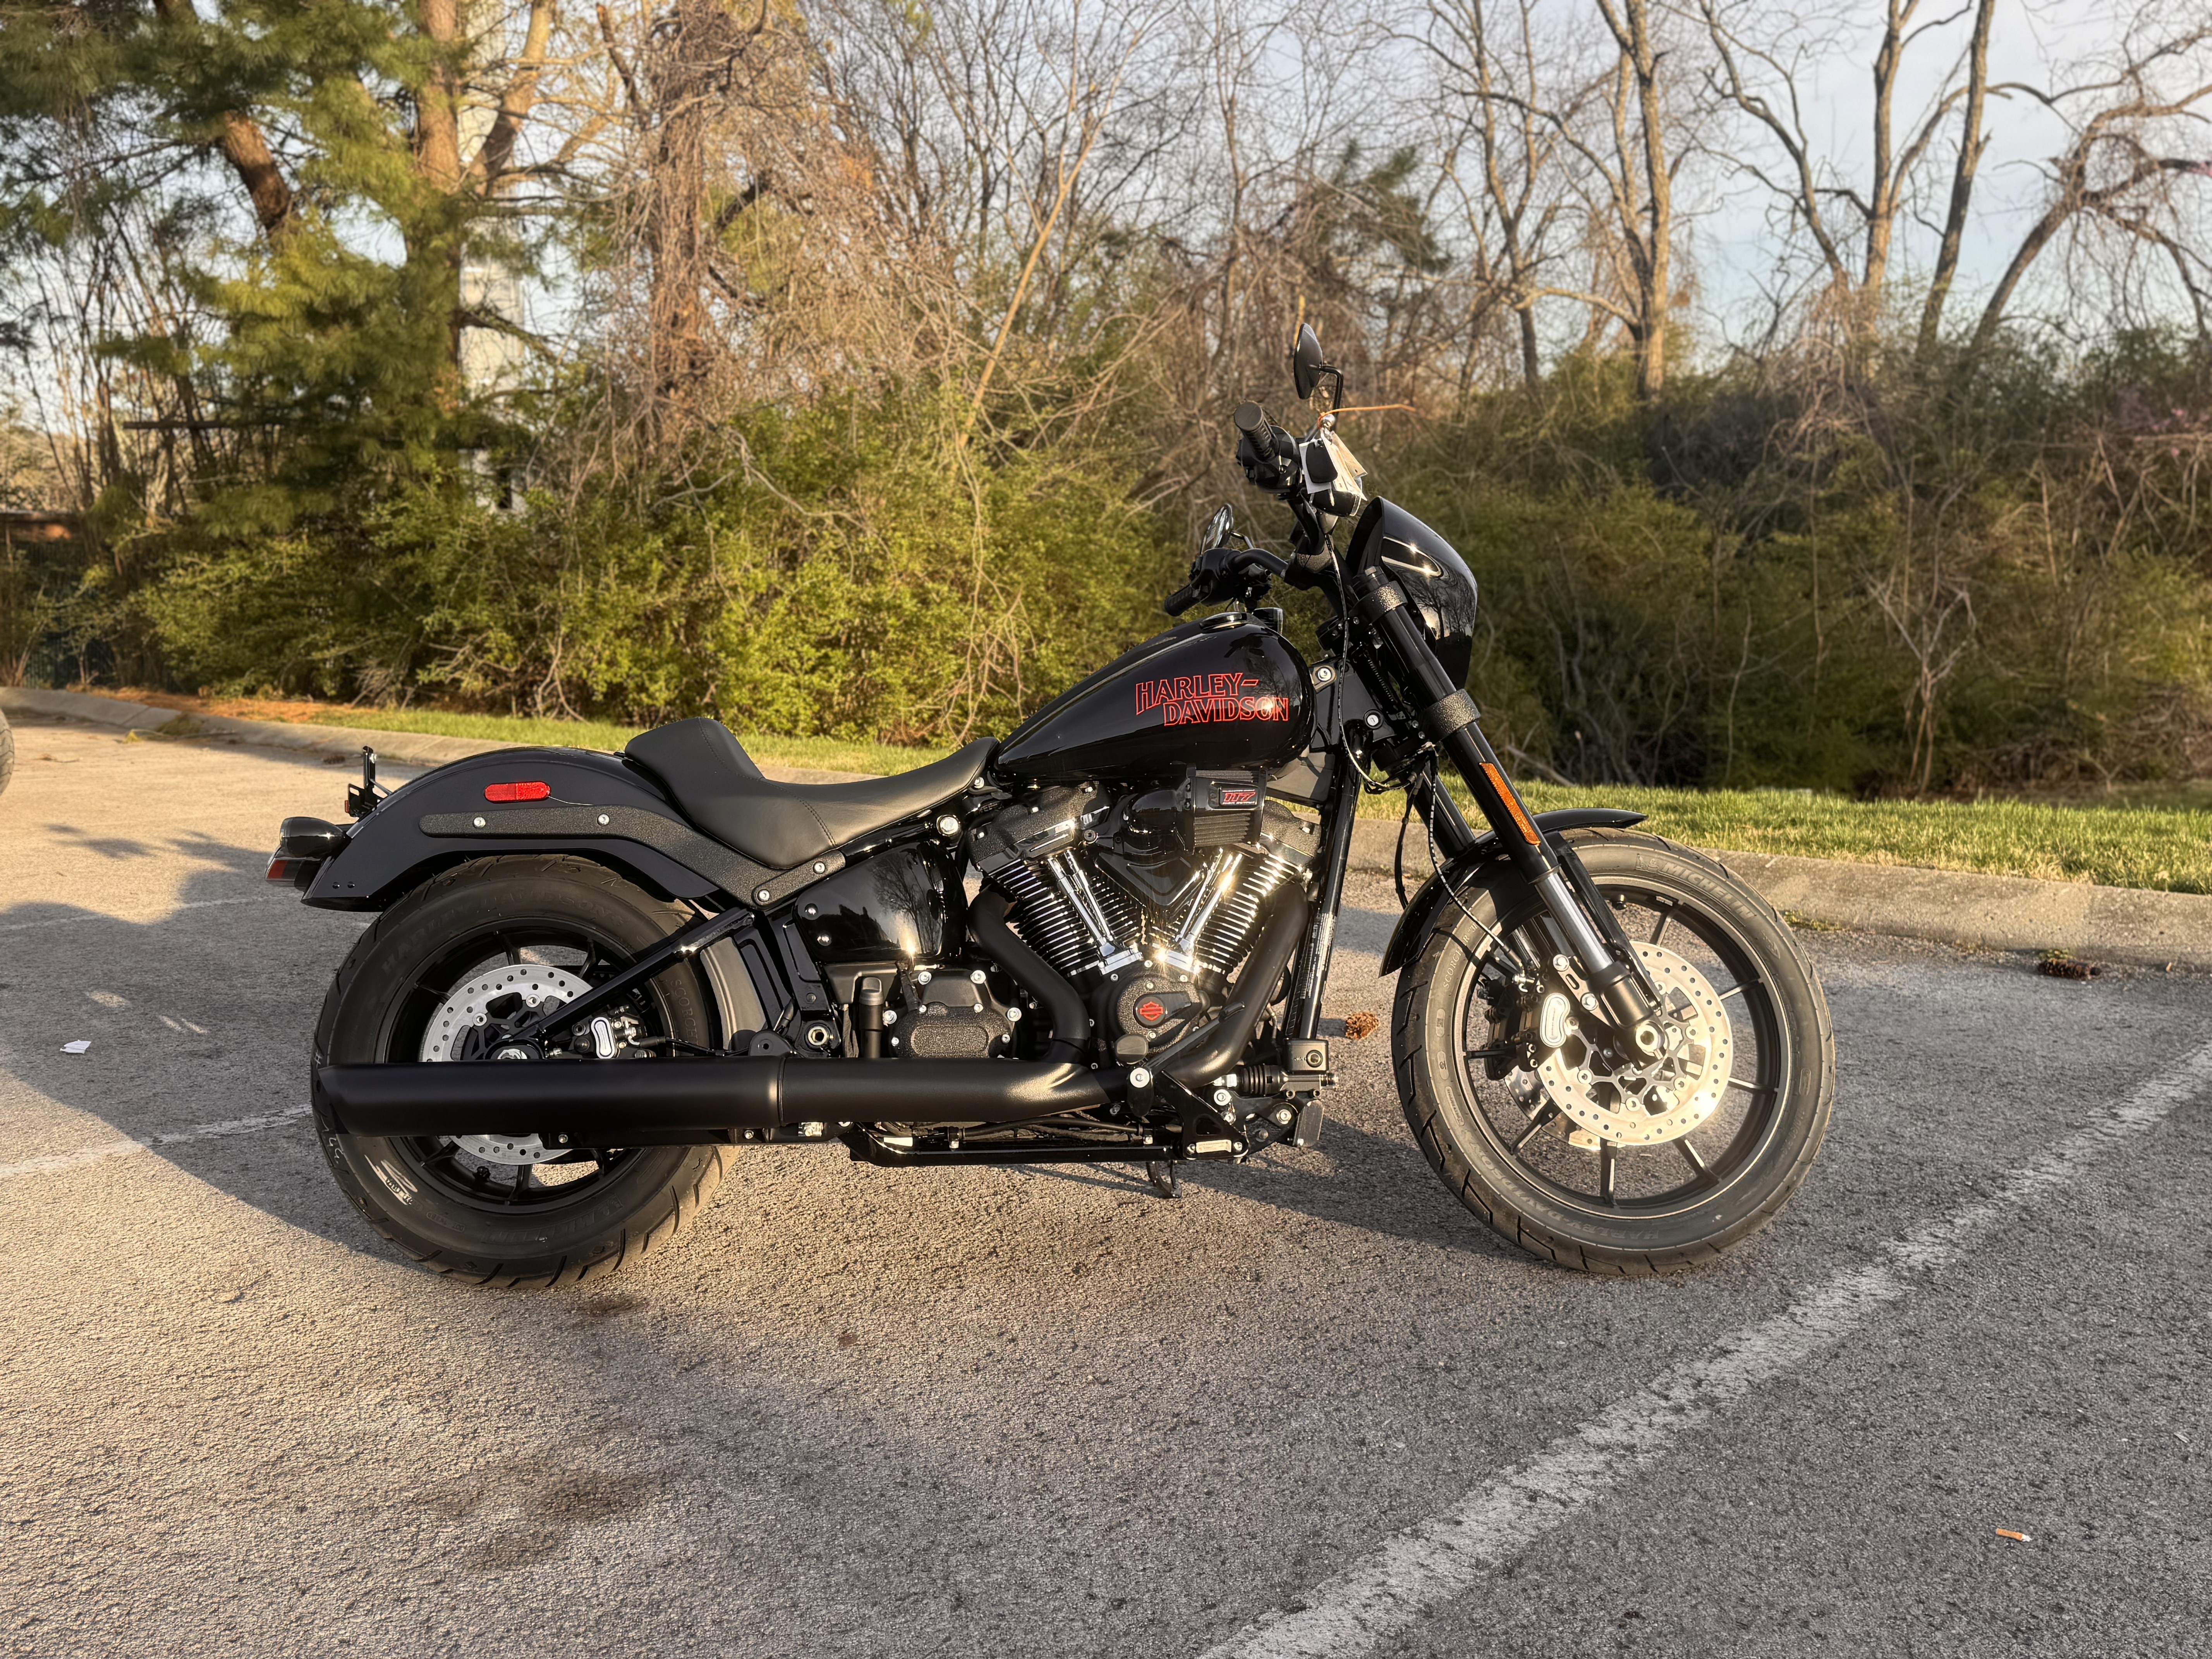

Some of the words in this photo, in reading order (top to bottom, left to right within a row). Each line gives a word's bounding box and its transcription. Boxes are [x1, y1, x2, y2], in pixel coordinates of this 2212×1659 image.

[1136, 673, 1259, 715] HARLEY-
[1163, 696, 1289, 726] DAVIDSON
[1661, 862, 1753, 919] MICHELIN
[1443, 935, 1470, 989] SCORCHR
[671, 979, 698, 1045] SCORCH
